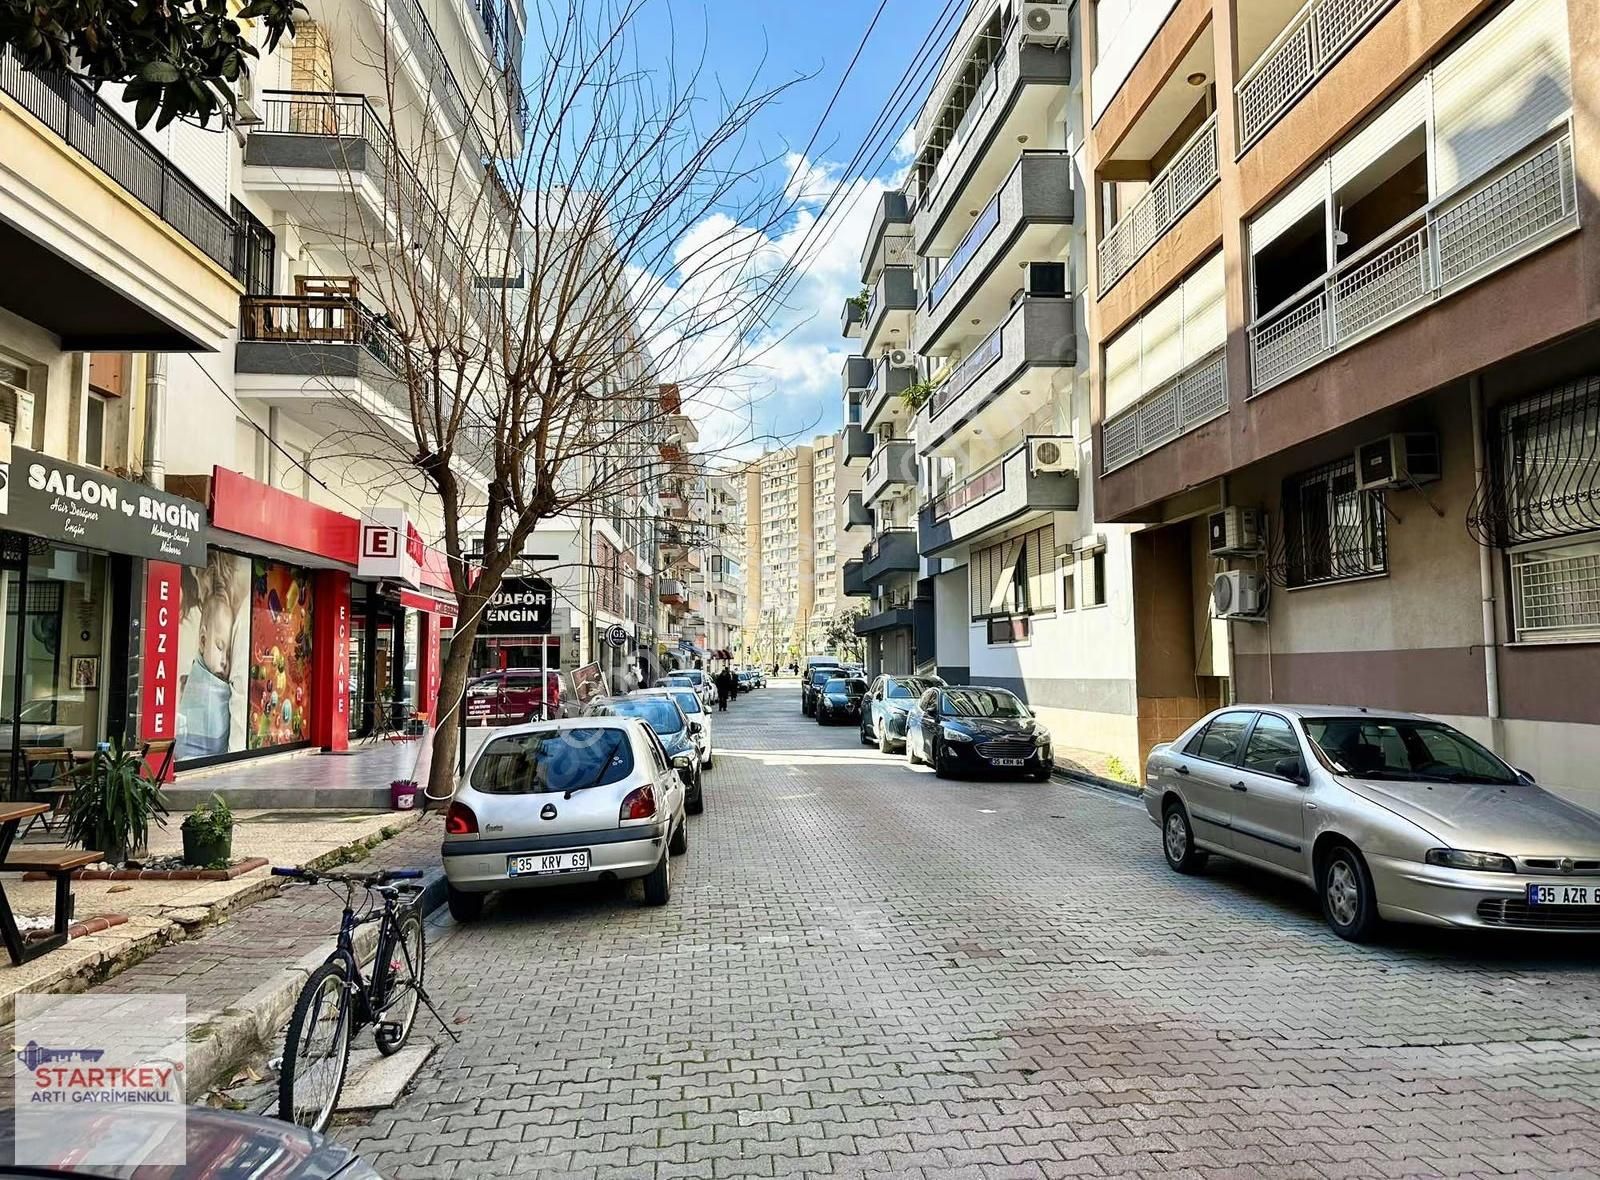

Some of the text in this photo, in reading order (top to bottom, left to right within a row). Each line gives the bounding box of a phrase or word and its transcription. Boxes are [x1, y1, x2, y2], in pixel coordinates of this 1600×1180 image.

[28, 464, 199, 531] SALON by ENGİN
[50, 497, 99, 524] Hair Designer
[64, 518, 86, 538] Engin
[372, 531, 389, 553] E
[486, 607, 539, 622] ENGİN
[613, 629, 625, 638] GE
[154, 581, 169, 733] ECZANE
[518, 858, 532, 872] 35
[541, 855, 562, 869] KRV
[571, 853, 586, 867] 69
[1538, 887, 1555, 903] 35
[1563, 887, 1587, 904] AZR
